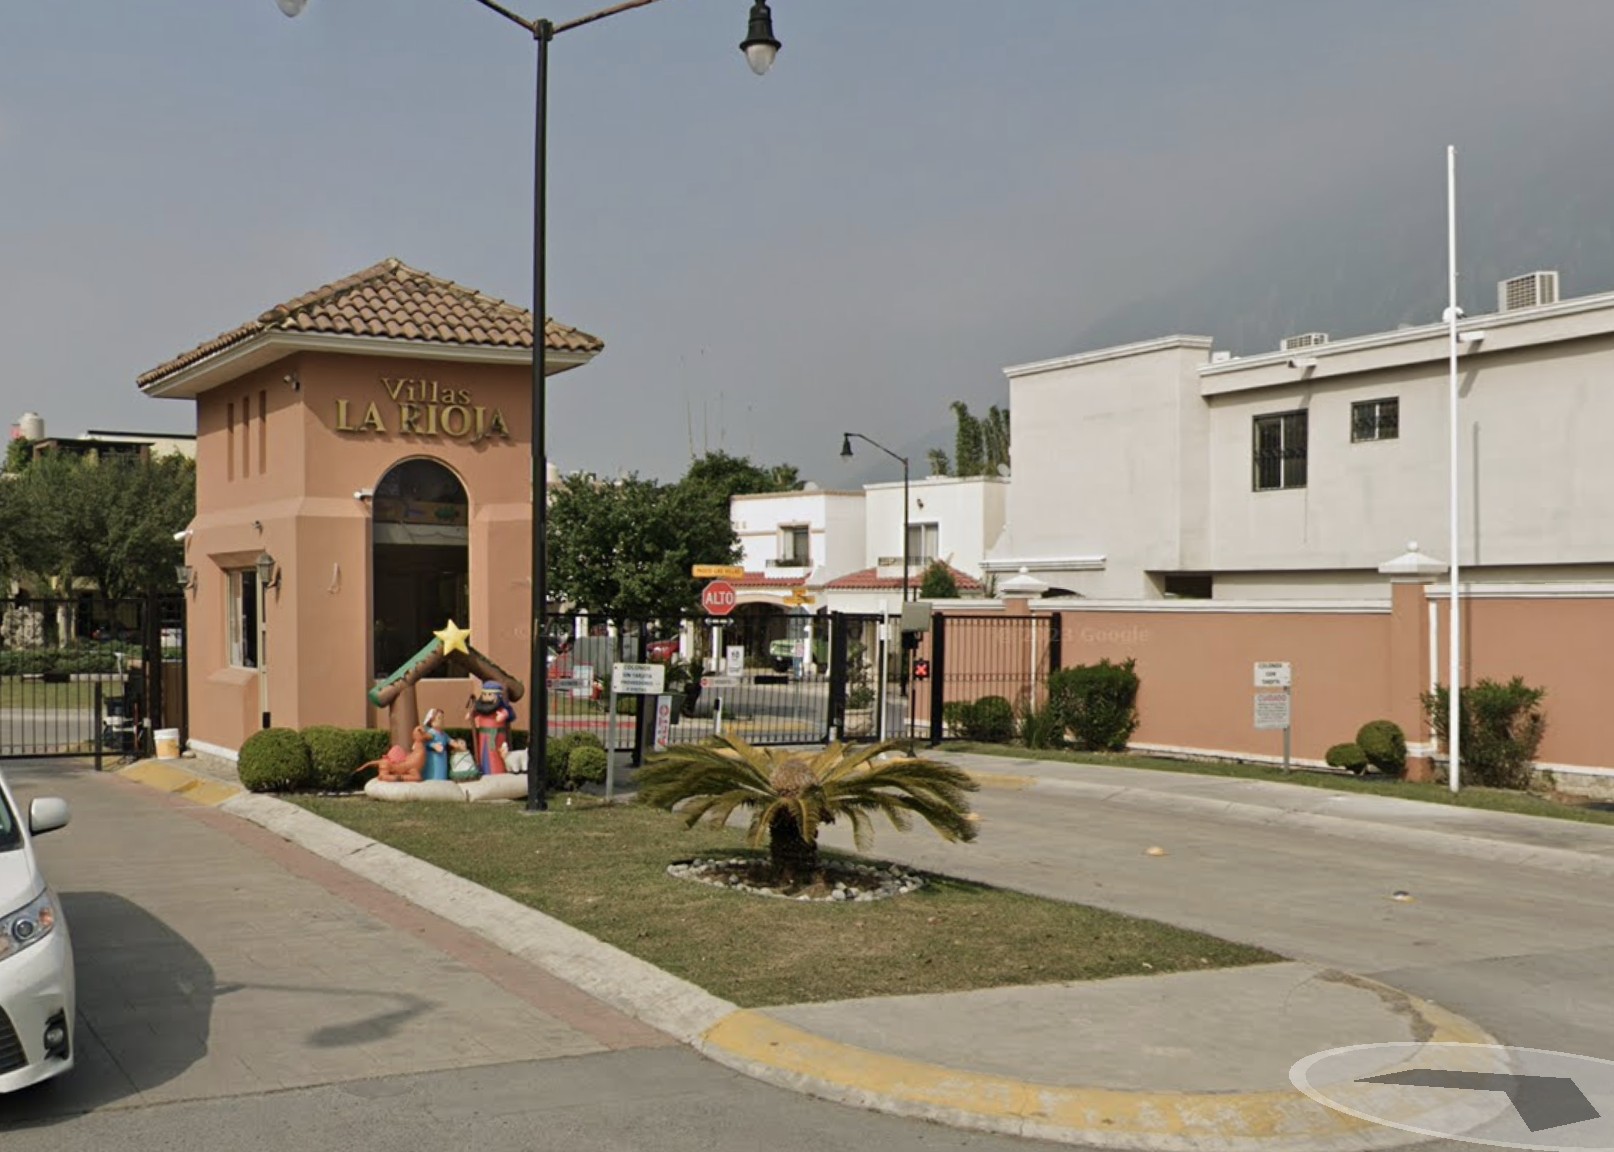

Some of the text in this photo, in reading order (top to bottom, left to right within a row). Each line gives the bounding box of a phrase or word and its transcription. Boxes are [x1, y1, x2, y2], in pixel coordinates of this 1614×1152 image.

[382, 377, 472, 405] Villas
[336, 399, 510, 443] LA RIOJA
[705, 591, 734, 605] ALTO
[657, 704, 670, 748] ALTO
